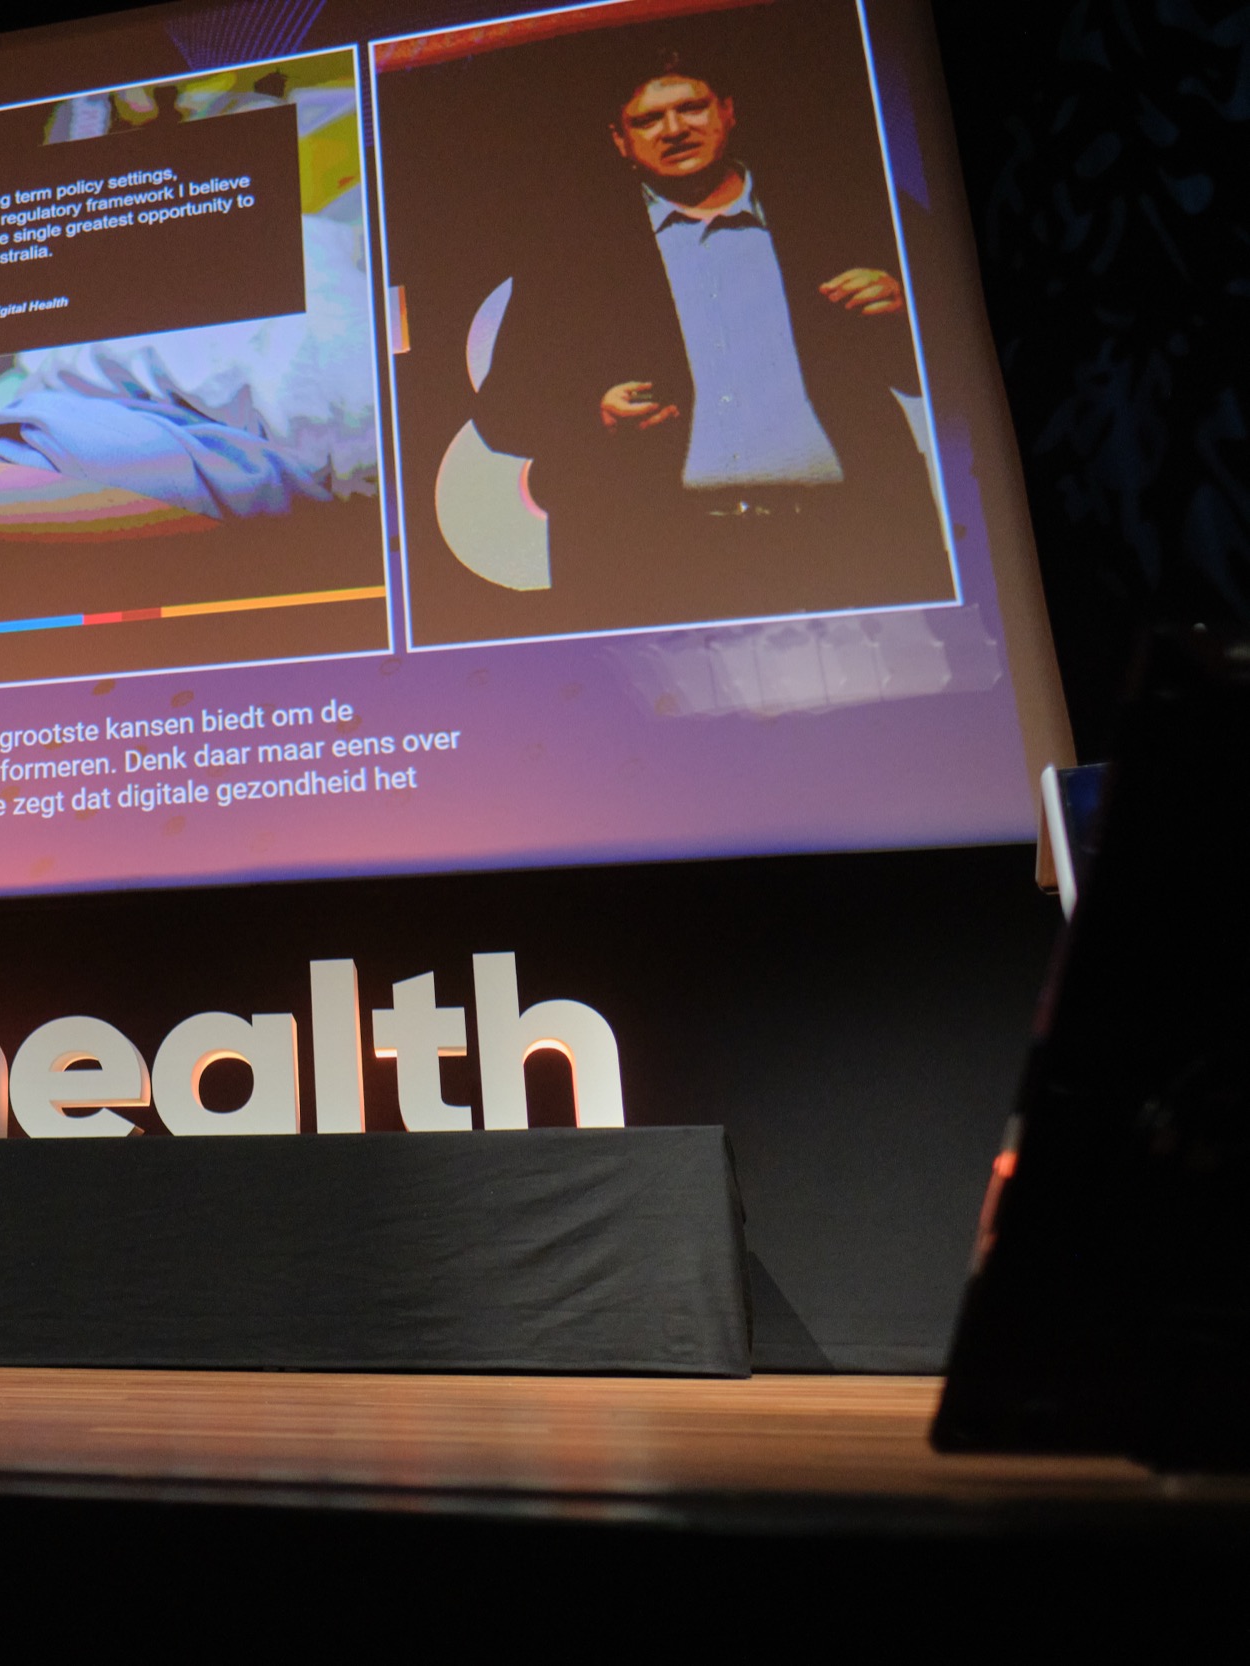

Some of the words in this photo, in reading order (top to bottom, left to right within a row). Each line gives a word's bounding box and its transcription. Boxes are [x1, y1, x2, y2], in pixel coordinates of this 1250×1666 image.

[0, 202, 82, 225] regulatory
[85, 186, 174, 212] framework
[178, 183, 183, 197] I
[188, 176, 250, 196] believe
[14, 188, 51, 204] term
[56, 179, 103, 200] policy
[107, 168, 177, 189] settings,
[12, 223, 61, 242] single
[65, 211, 133, 237] greatest
[137, 197, 232, 225] opportunity
[236, 194, 254, 208] to
[28, 296, 68, 311] Health
[106, 716, 193, 739] kansen
[201, 704, 264, 732] biedt
[271, 706, 312, 726] om
[320, 698, 353, 723] de
[124, 745, 186, 772] Denk
[193, 743, 250, 767] daar
[258, 741, 324, 763] maar
[331, 735, 394, 757] eens
[402, 730, 460, 752] over
[12, 791, 64, 817] zegt
[71, 786, 110, 810] dat
[117, 778, 208, 810] digitale
[216, 766, 366, 805] gezondheid
[374, 765, 417, 790] het
